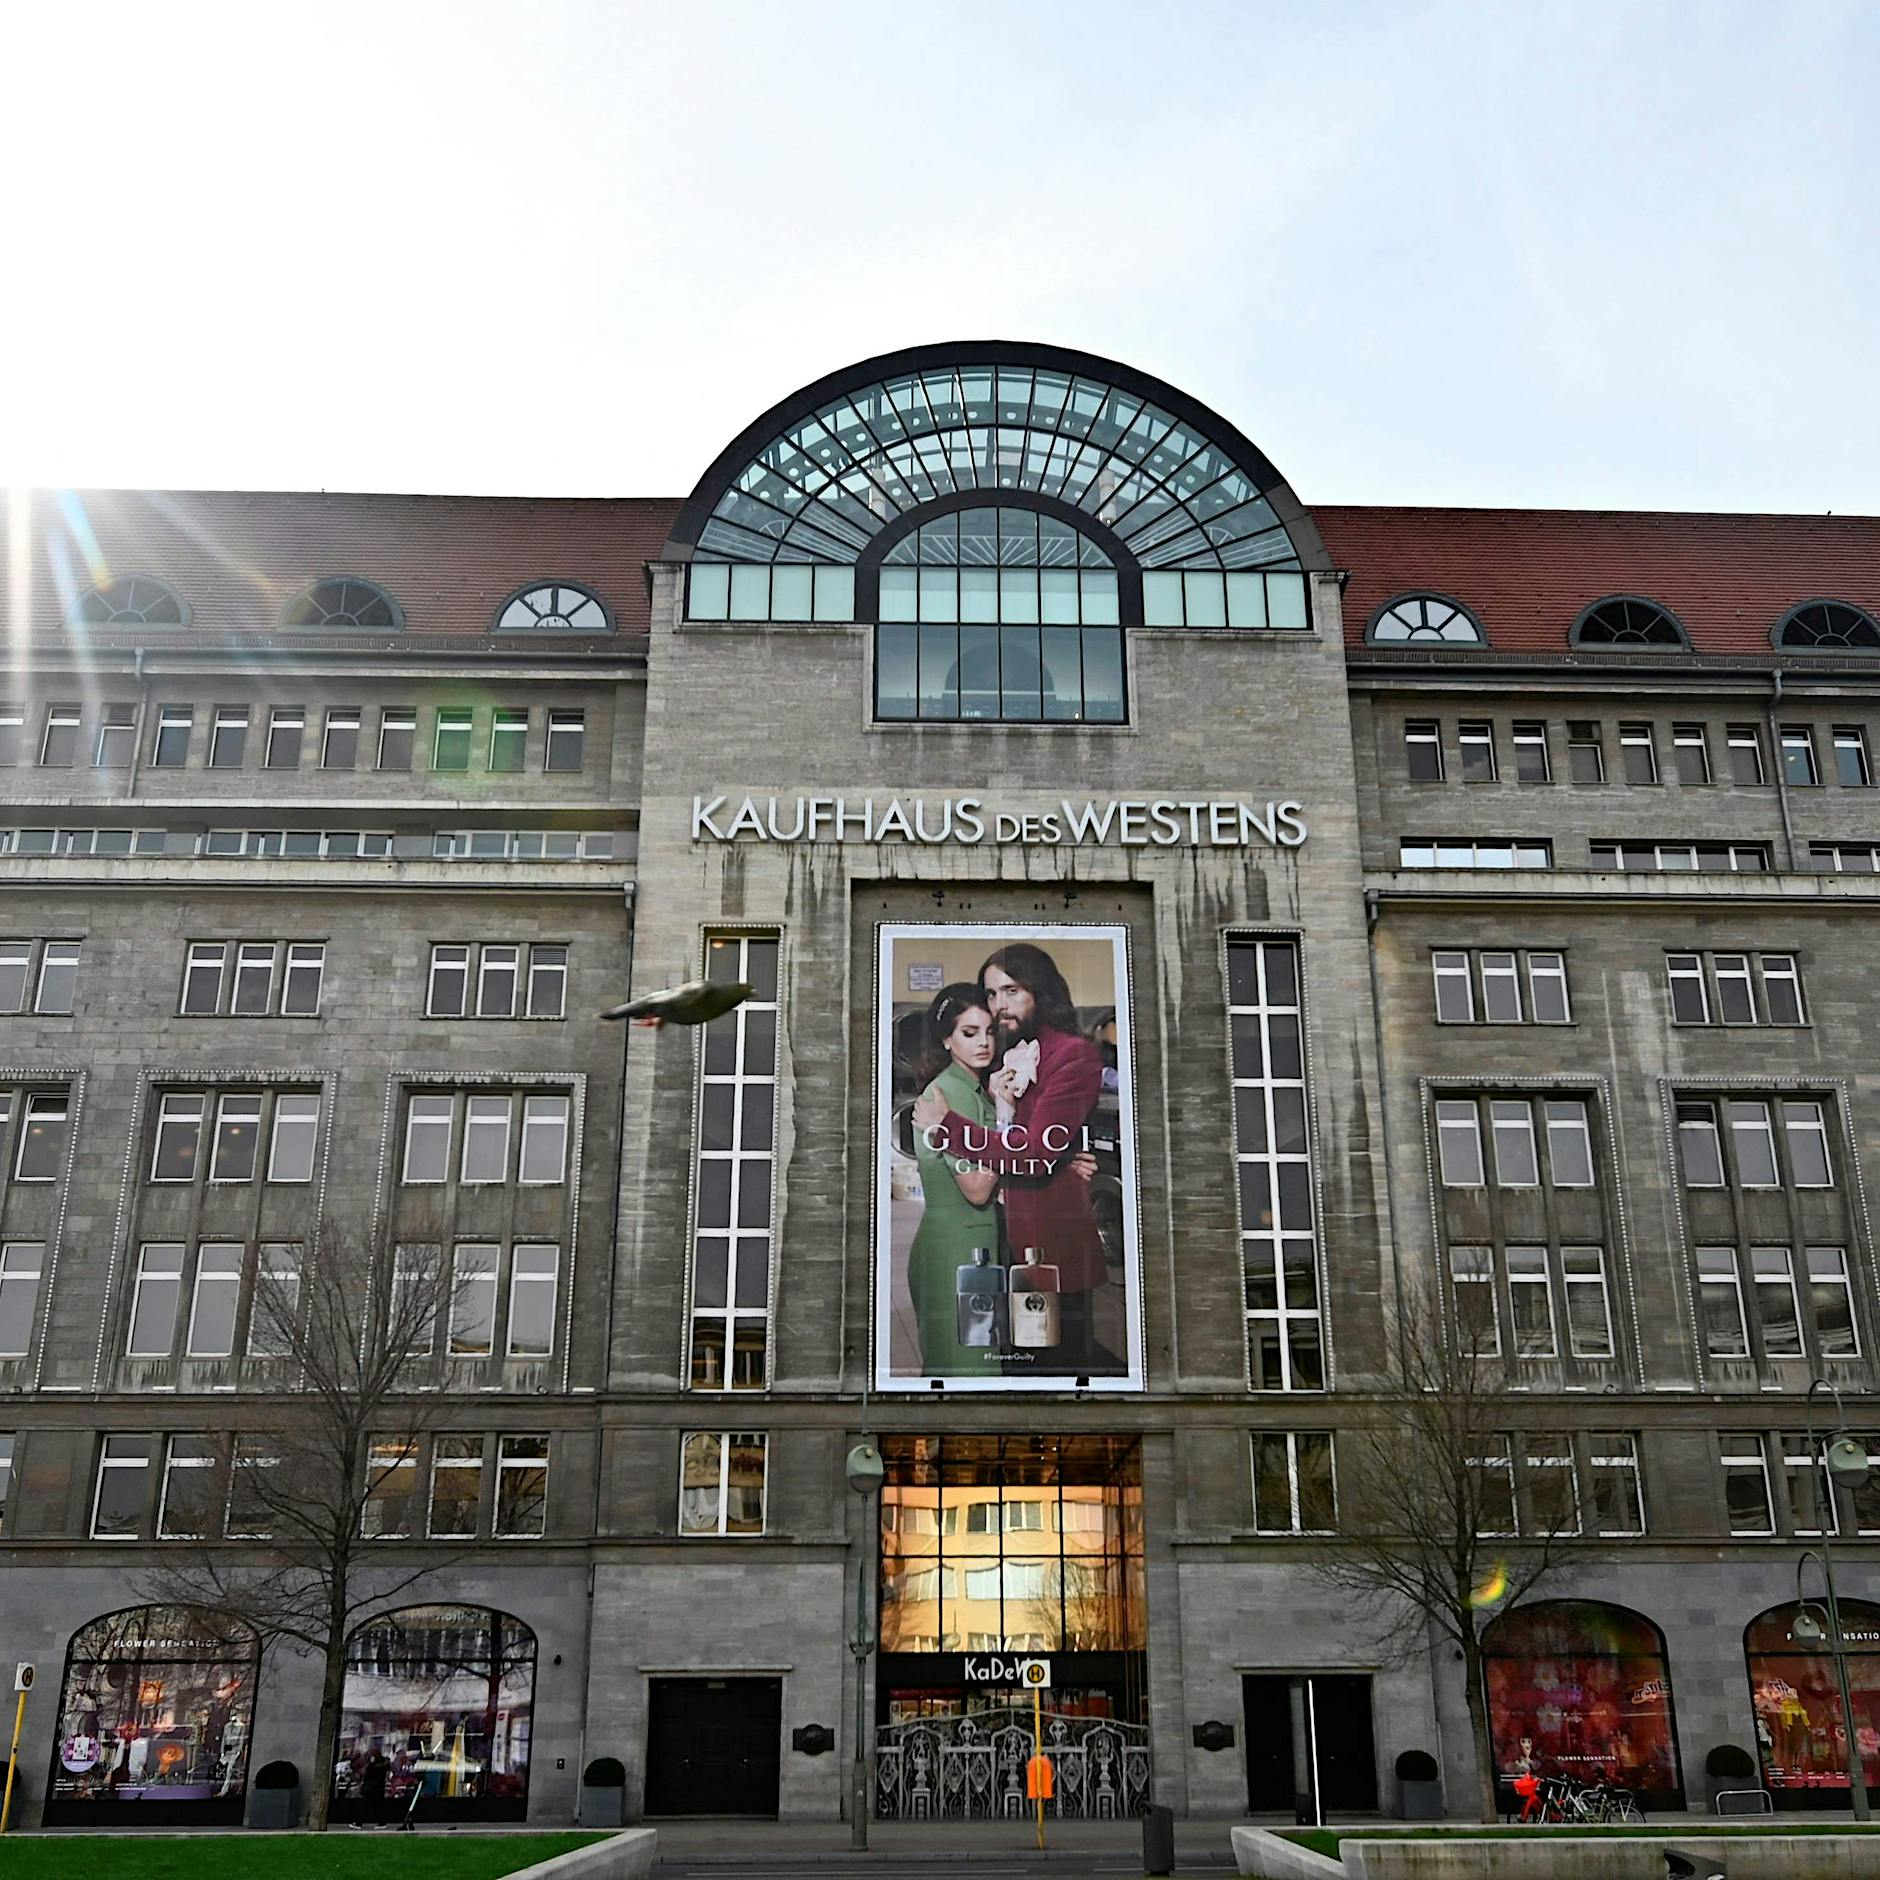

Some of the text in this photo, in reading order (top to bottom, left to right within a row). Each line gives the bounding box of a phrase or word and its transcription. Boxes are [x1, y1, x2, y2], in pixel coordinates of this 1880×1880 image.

[691, 795, 1308, 847] KAUFHAUS DES WESTENS
[922, 1123, 1090, 1152] GUCCI
[954, 1158, 1059, 1175] GUILTY
[113, 1639, 156, 1648] FLOWER
